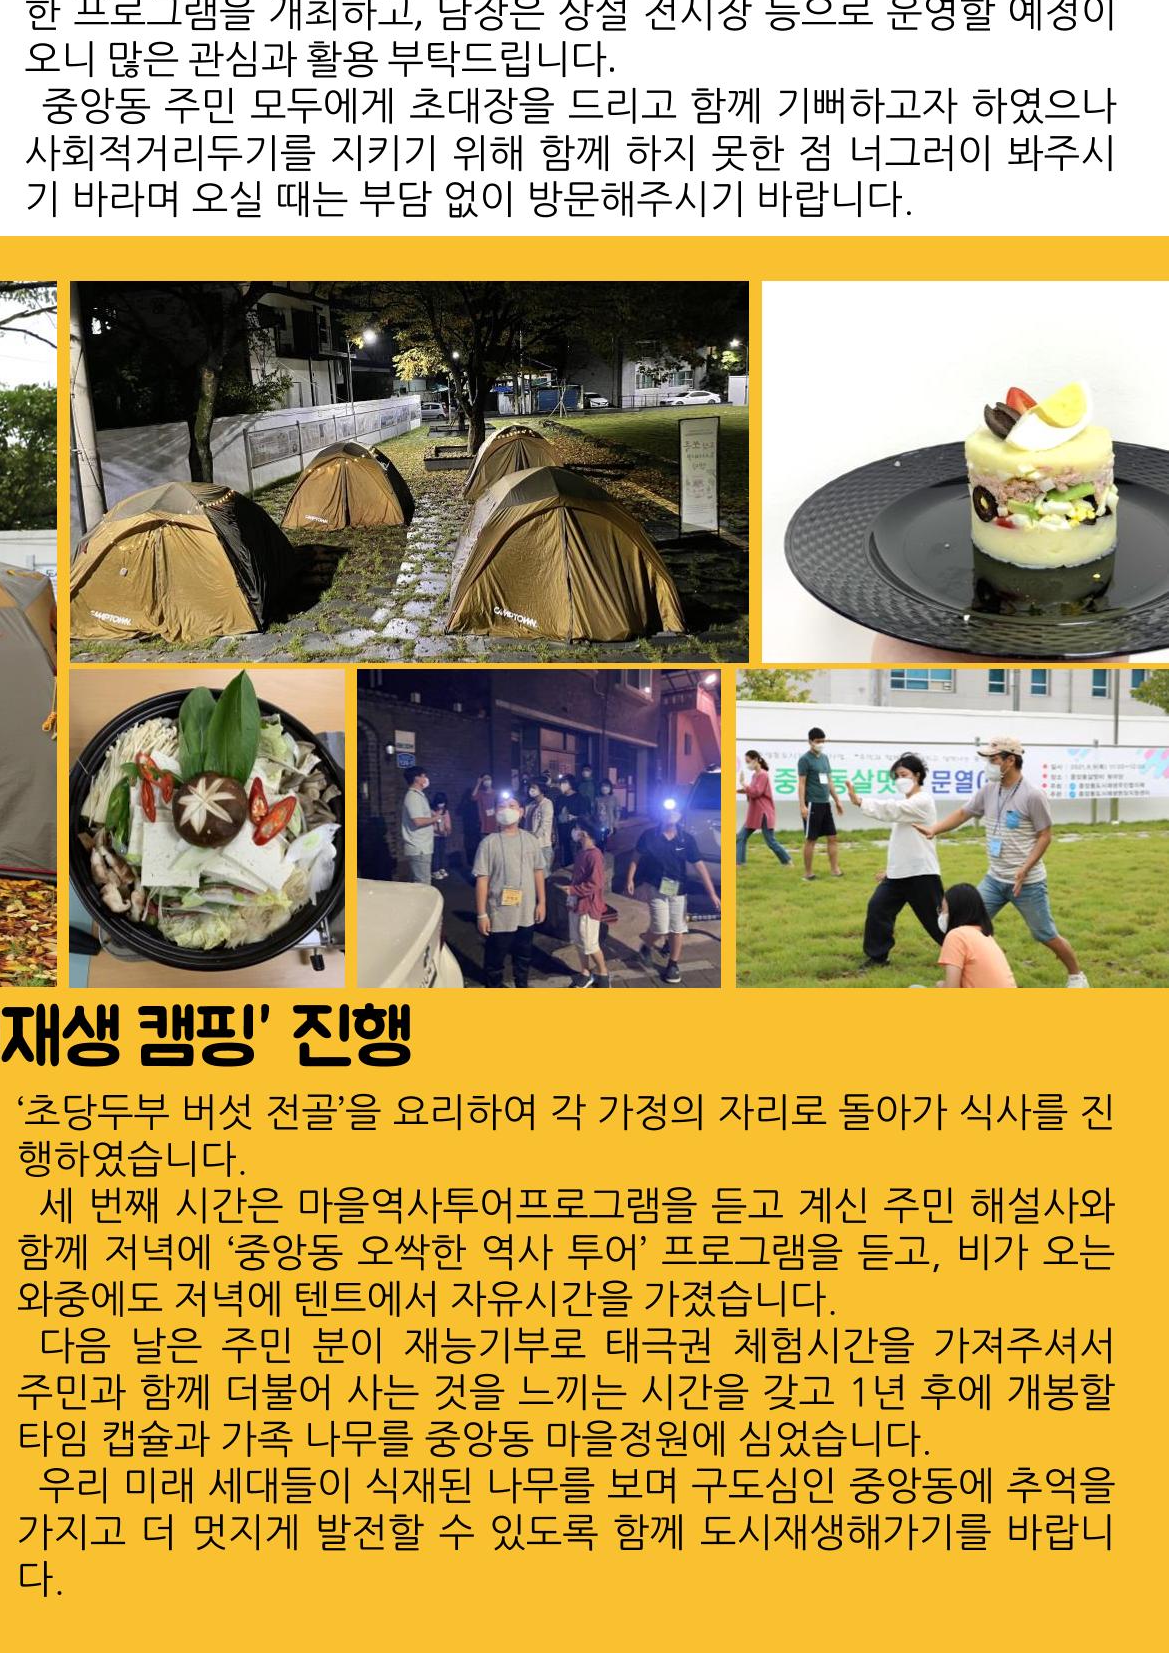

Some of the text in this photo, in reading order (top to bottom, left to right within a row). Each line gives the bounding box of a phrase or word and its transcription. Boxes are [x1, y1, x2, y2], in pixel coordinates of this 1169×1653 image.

[28, 181, 911, 218] 기 바라며 오실 때는 부담 없이 방문해주시기 바랍니다.
[138, 1004, 269, 1067] 캠핑’
[293, 1003, 411, 1067] 진행
[18, 1094, 1112, 1130] ‘초당두부 버섯 전골’을 요리하여 각 가정의 자리로 돌아가 식사를 진
[19, 1141, 244, 1177] 행하였습니다.
